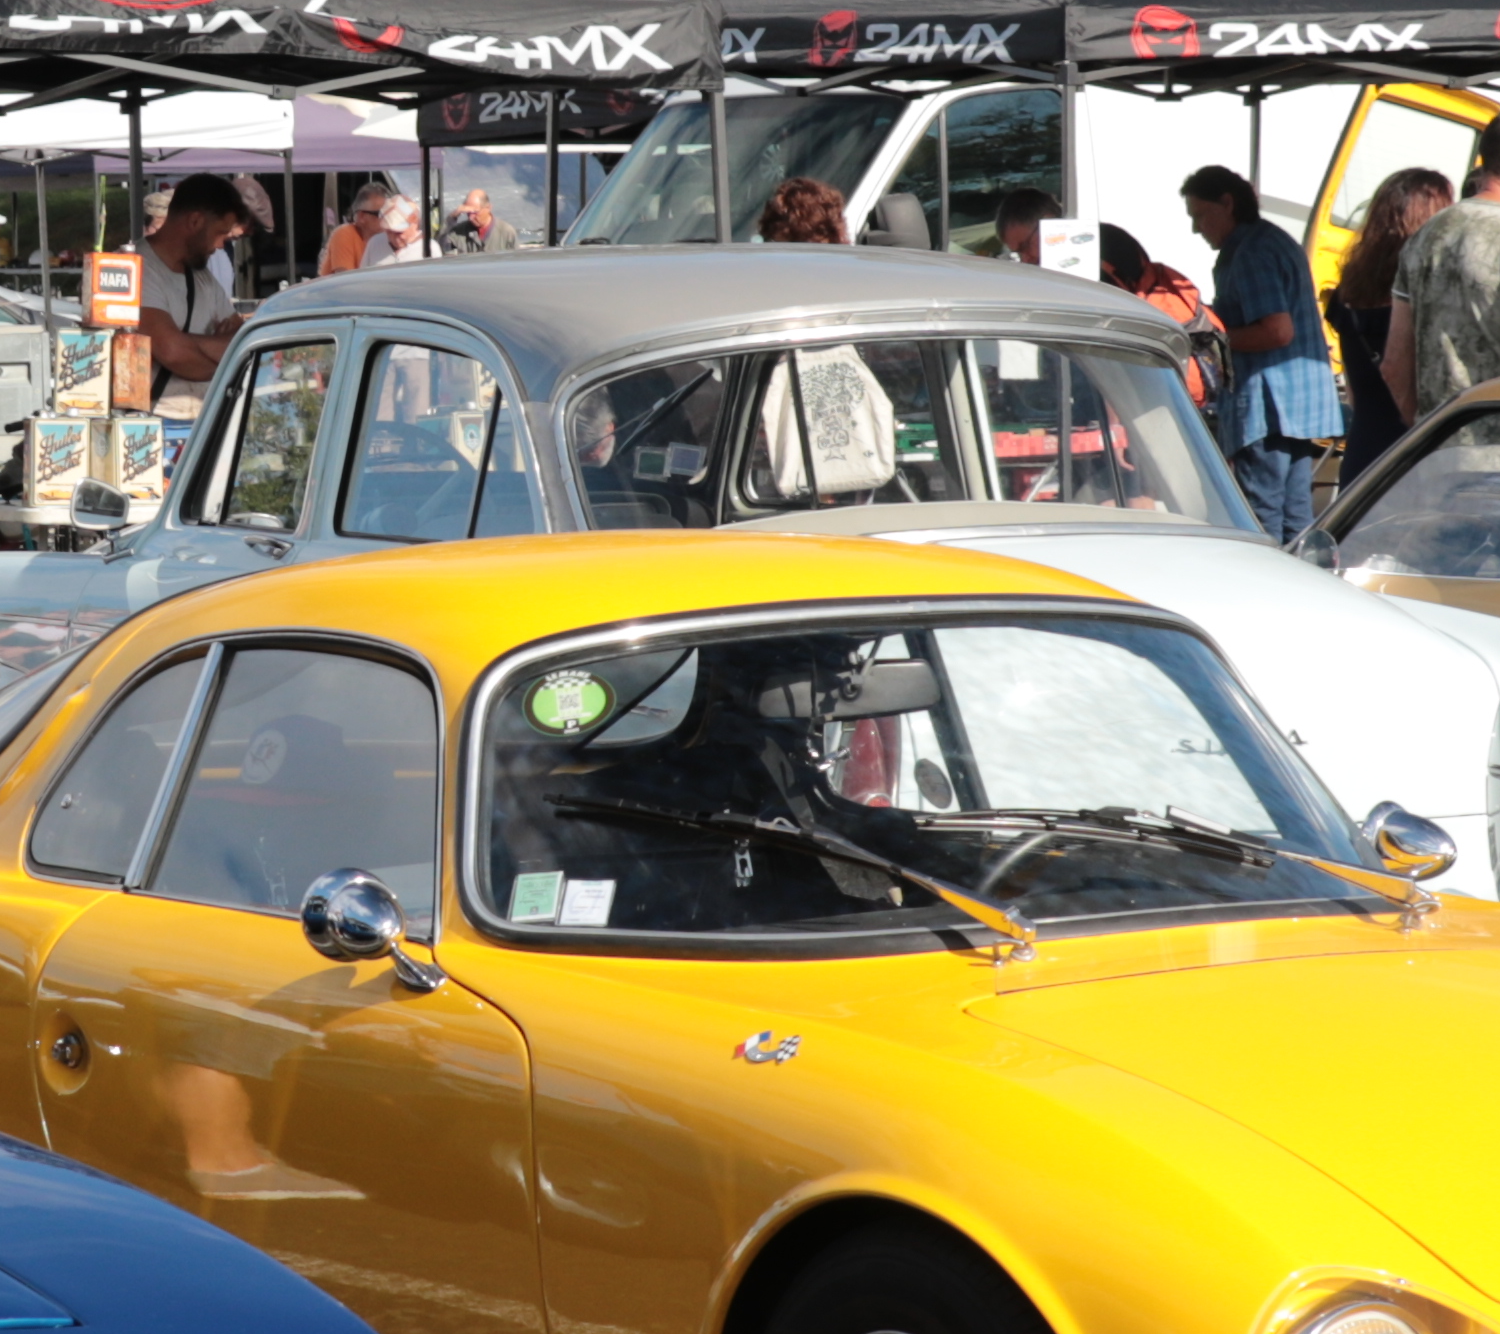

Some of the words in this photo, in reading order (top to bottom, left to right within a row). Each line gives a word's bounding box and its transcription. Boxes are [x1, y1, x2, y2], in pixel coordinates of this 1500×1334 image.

[854, 23, 1021, 64] 24MX
[1208, 22, 1430, 58] 24MX
[100, 271, 129, 289] HAFA
